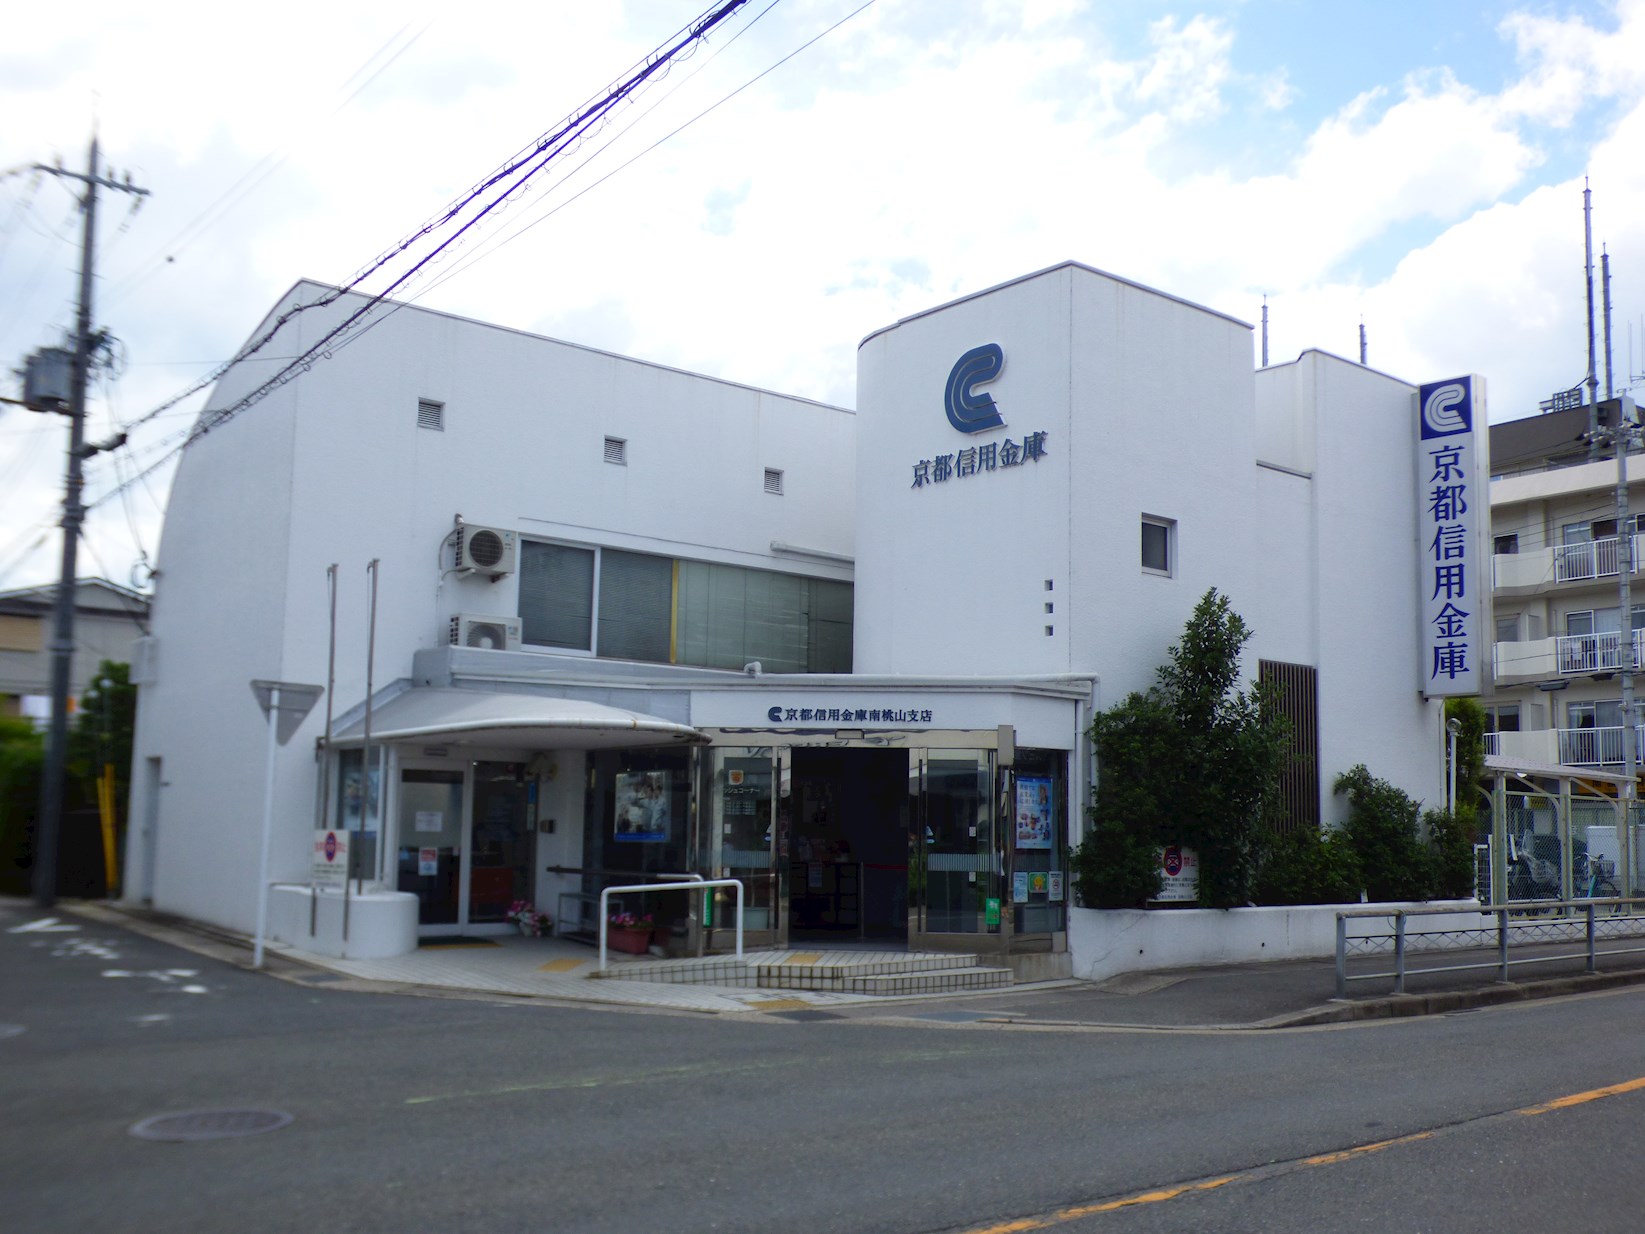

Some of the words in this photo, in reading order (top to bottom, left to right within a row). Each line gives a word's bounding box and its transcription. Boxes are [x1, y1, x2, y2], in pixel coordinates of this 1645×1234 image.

[911, 431, 1048, 489] 京都信用金庫
[1428, 444, 1470, 680] 京都信用金庫
[784, 708, 933, 723] 京都信用金庫南桃山支店
